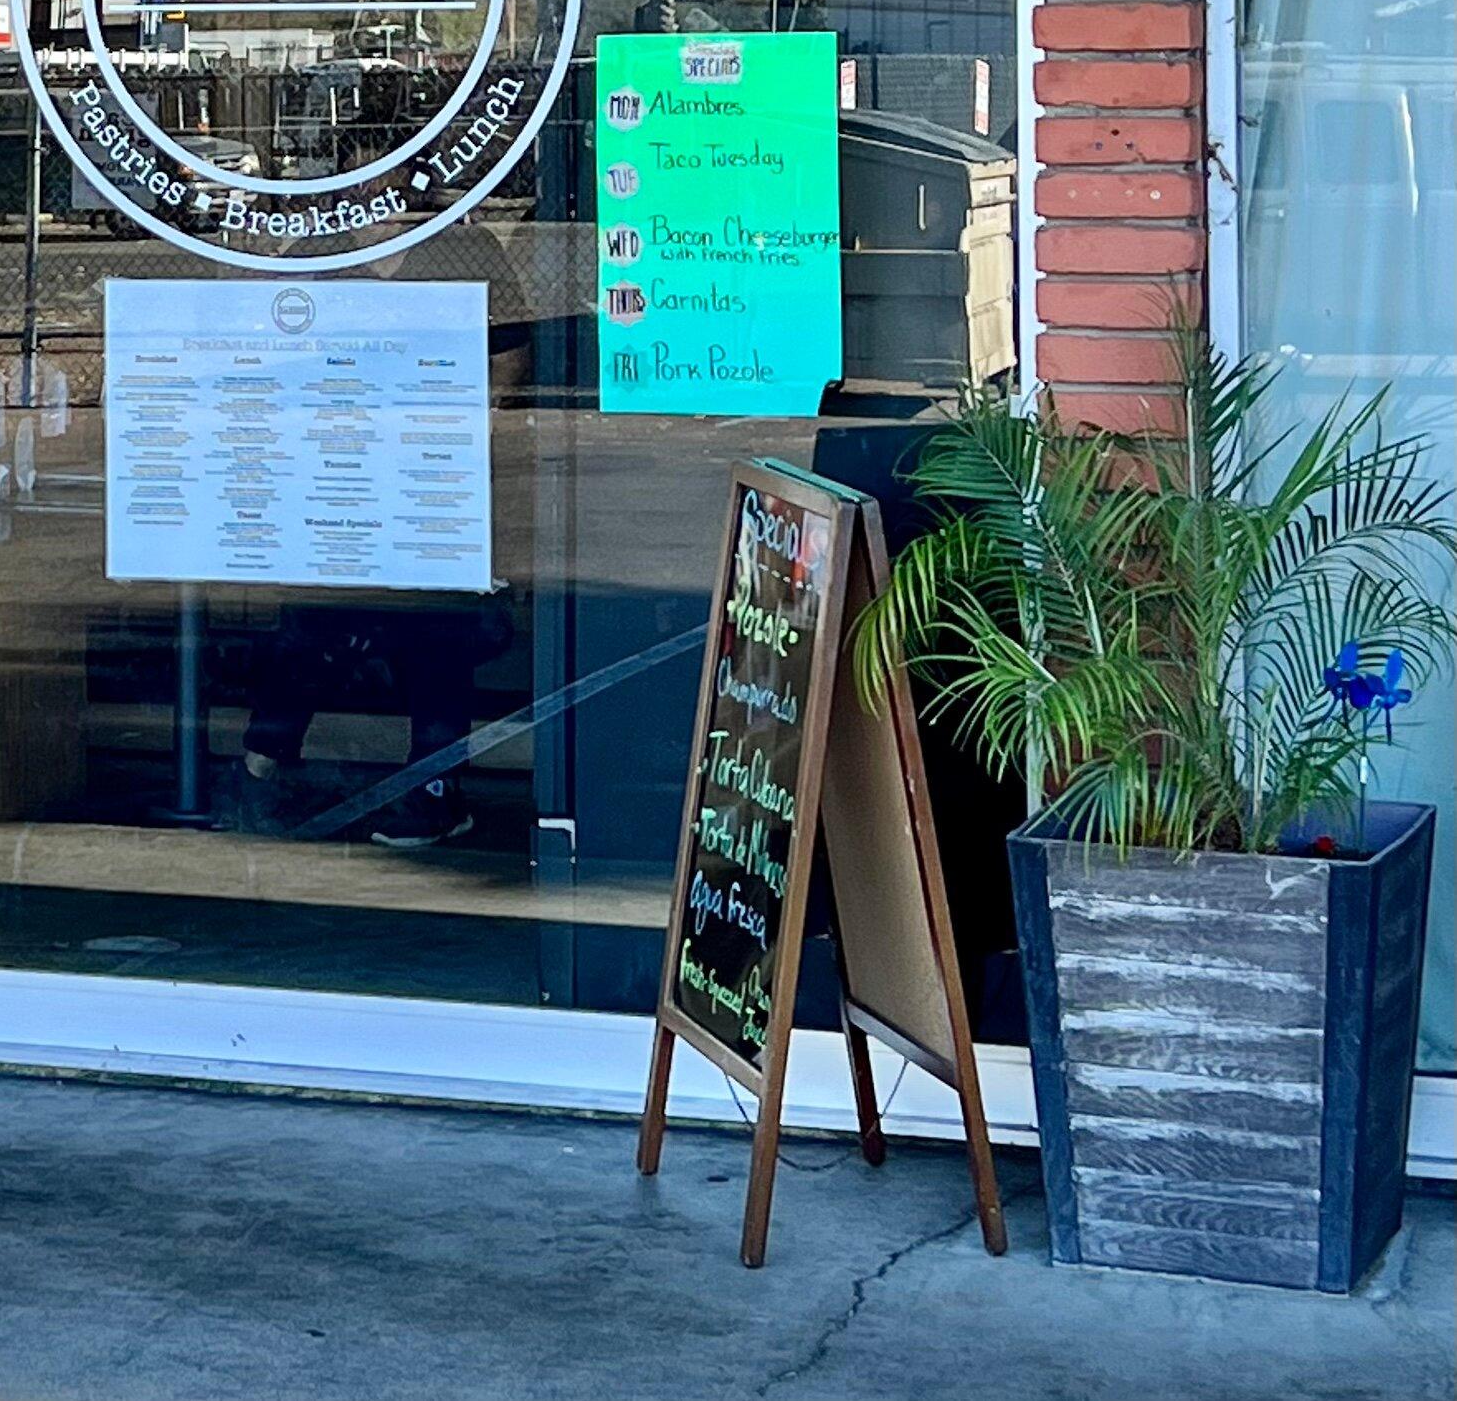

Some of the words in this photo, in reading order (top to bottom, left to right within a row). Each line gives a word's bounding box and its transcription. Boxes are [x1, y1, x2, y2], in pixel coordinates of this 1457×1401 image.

[648, 90, 746, 116] Alambres
[71, 79, 188, 206] Pastries
[220, 185, 407, 238] Breakfast
[429, 73, 525, 184] Lunch
[648, 141, 702, 170] Taco
[703, 139, 785, 175] Tuesday
[648, 214, 713, 246] Bacon
[651, 277, 747, 313] Carnitas
[652, 340, 703, 381] Pork
[708, 344, 774, 383] Pozole
